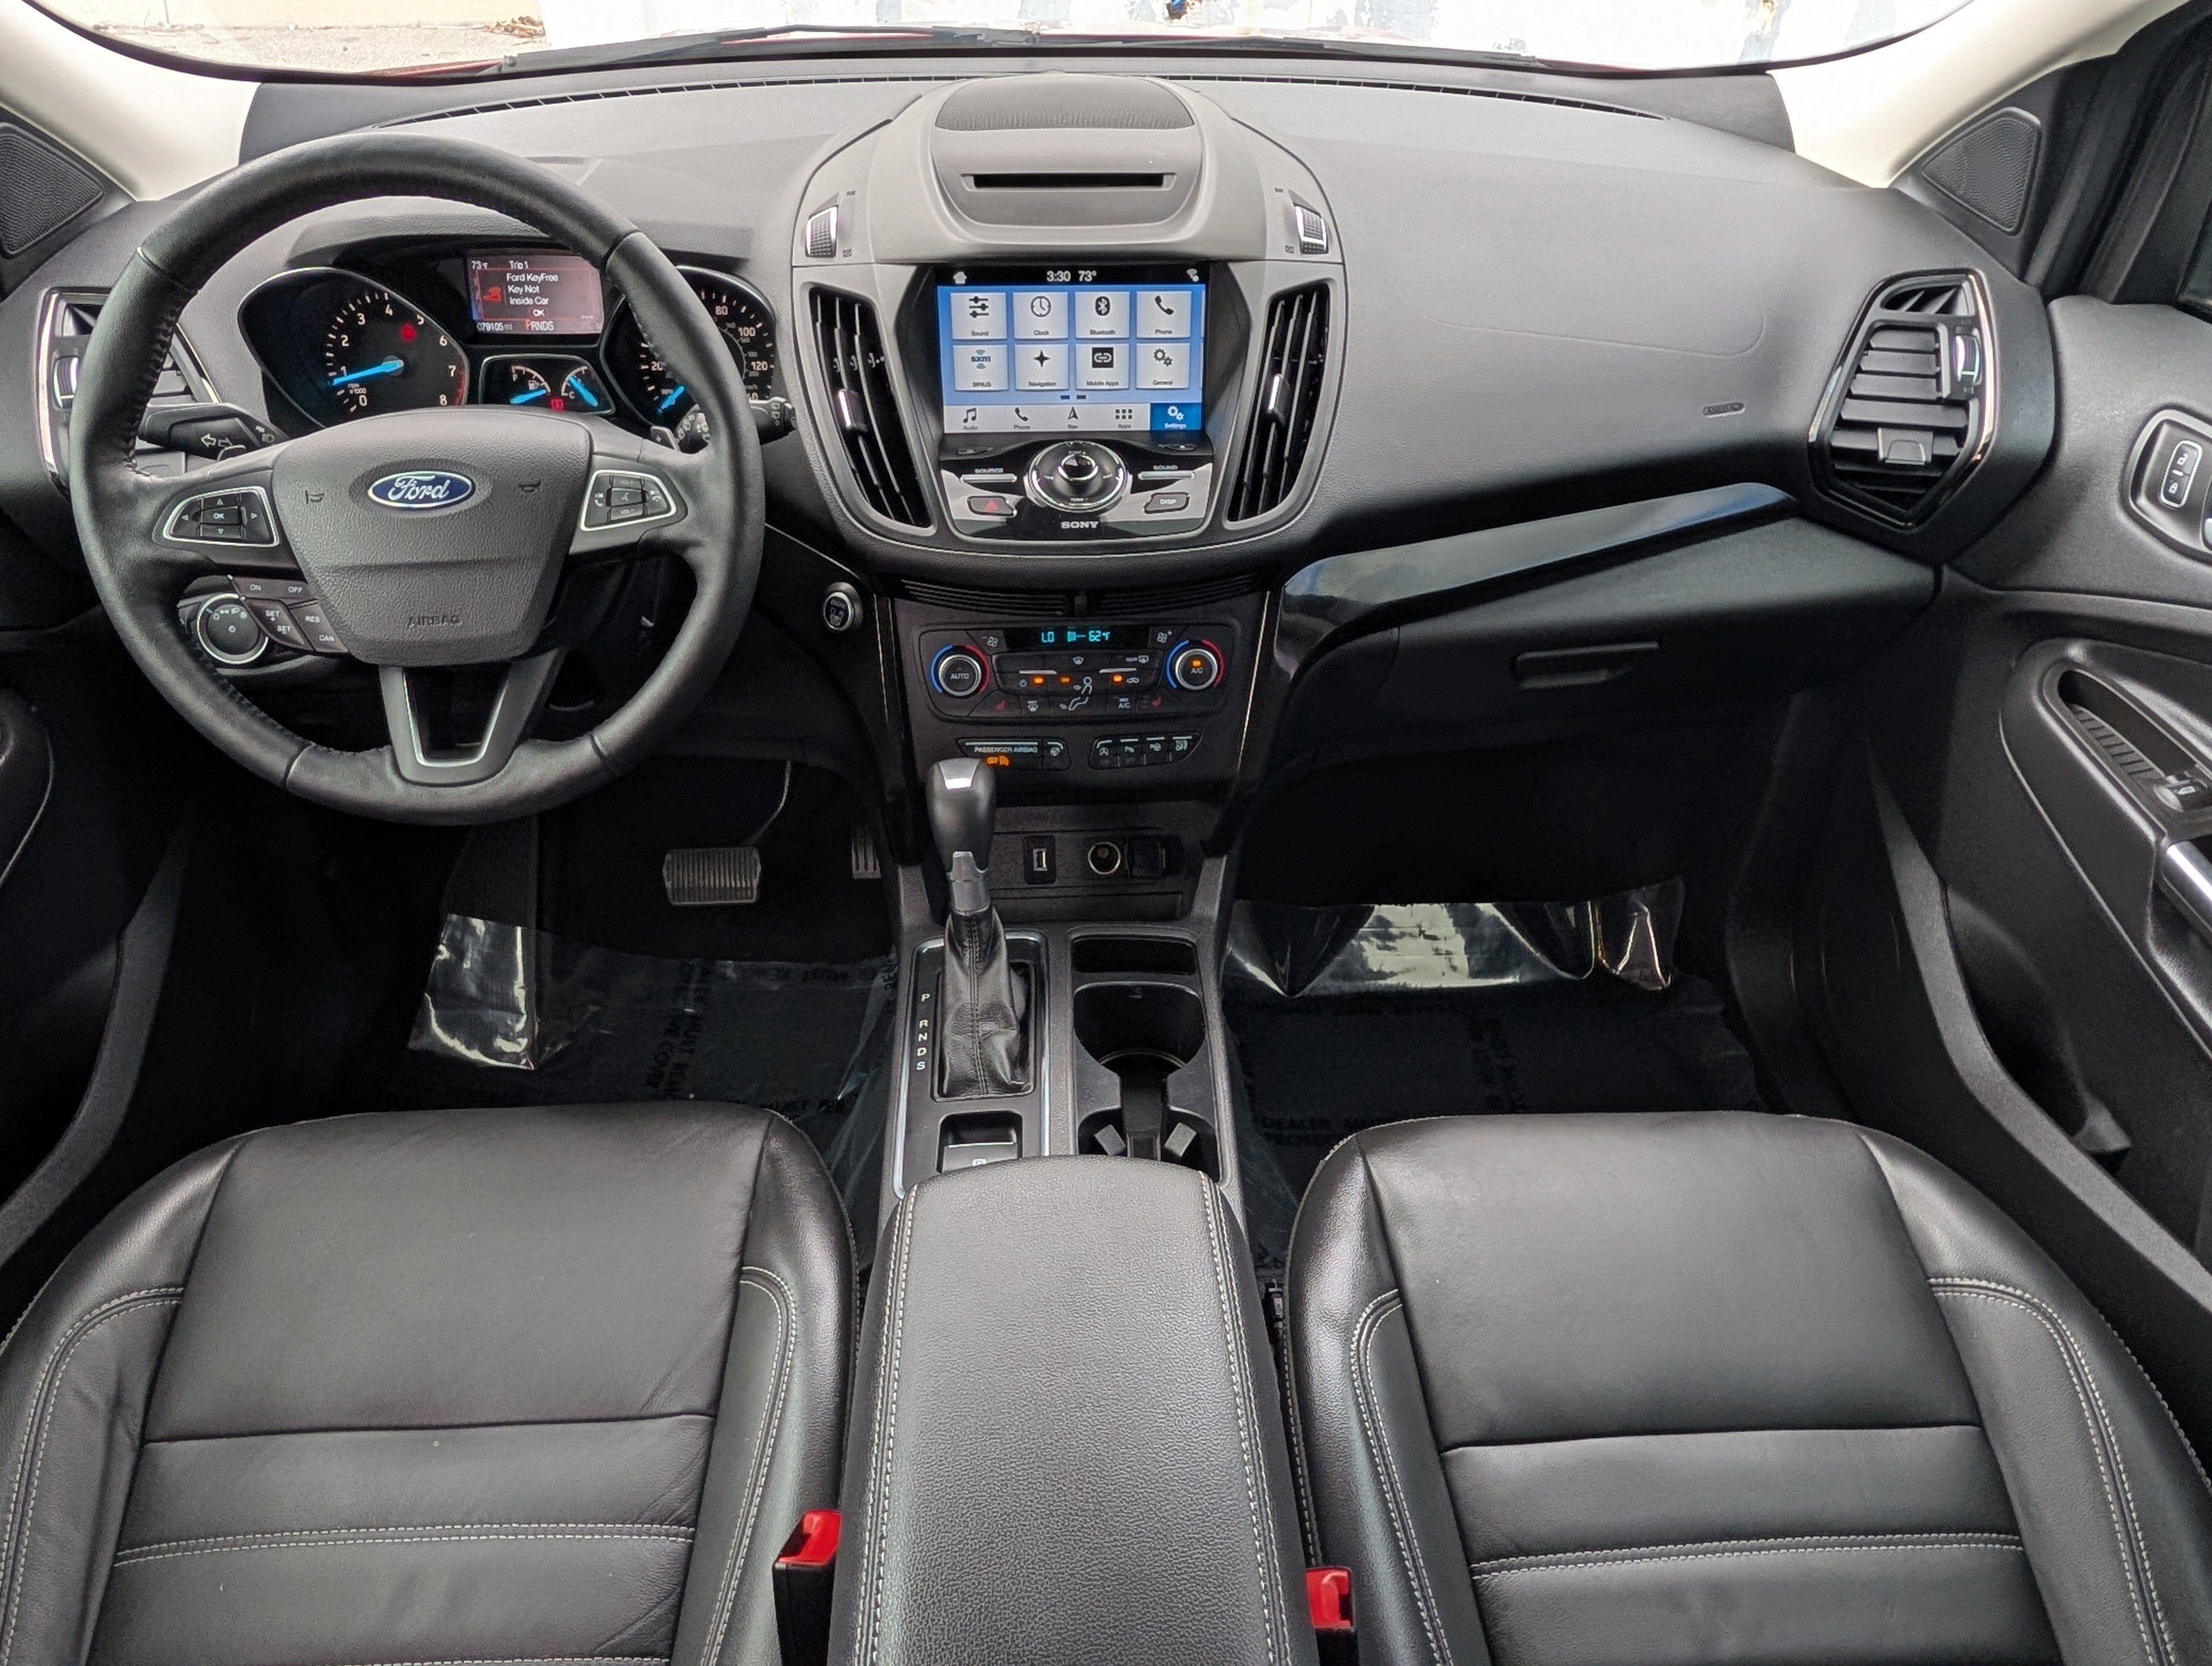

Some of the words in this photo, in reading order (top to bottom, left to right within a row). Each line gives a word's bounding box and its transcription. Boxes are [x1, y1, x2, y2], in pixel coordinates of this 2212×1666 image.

[509, 260, 523, 270] Trip
[506, 273, 525, 281] Ford
[526, 273, 558, 284] KeyFree
[1046, 270, 1071, 282] 3:30
[1078, 270, 1097, 282] 73°
[507, 285, 523, 295] Key
[524, 285, 540, 293] Not
[509, 296, 533, 305] Inside
[534, 296, 549, 305] Car
[385, 304, 393, 316] 4
[715, 305, 728, 316] 80
[357, 312, 366, 325] 3
[416, 314, 425, 325] 5
[738, 326, 756, 337] 100
[340, 334, 350, 347] 2
[439, 335, 448, 347] 6
[448, 365, 456, 377] 7
[750, 360, 769, 371] 120
[1028, 380, 1057, 388] Navigation
[359, 394, 368, 407] 0
[439, 394, 448, 406] 8
[1164, 422, 1187, 430] Settings
[388, 474, 451, 501] Ford
[1060, 521, 1099, 529] SONY
[249, 584, 262, 592] ON
[288, 586, 303, 594] OFF
[276, 625, 291, 633] SET
[319, 634, 335, 642] CAN
[1041, 631, 1055, 643] LO
[921, 993, 931, 1002] P
[919, 1018, 929, 1029] R
[918, 1032, 928, 1042] N
[917, 1047, 927, 1057] D
[916, 1060, 926, 1070] S
